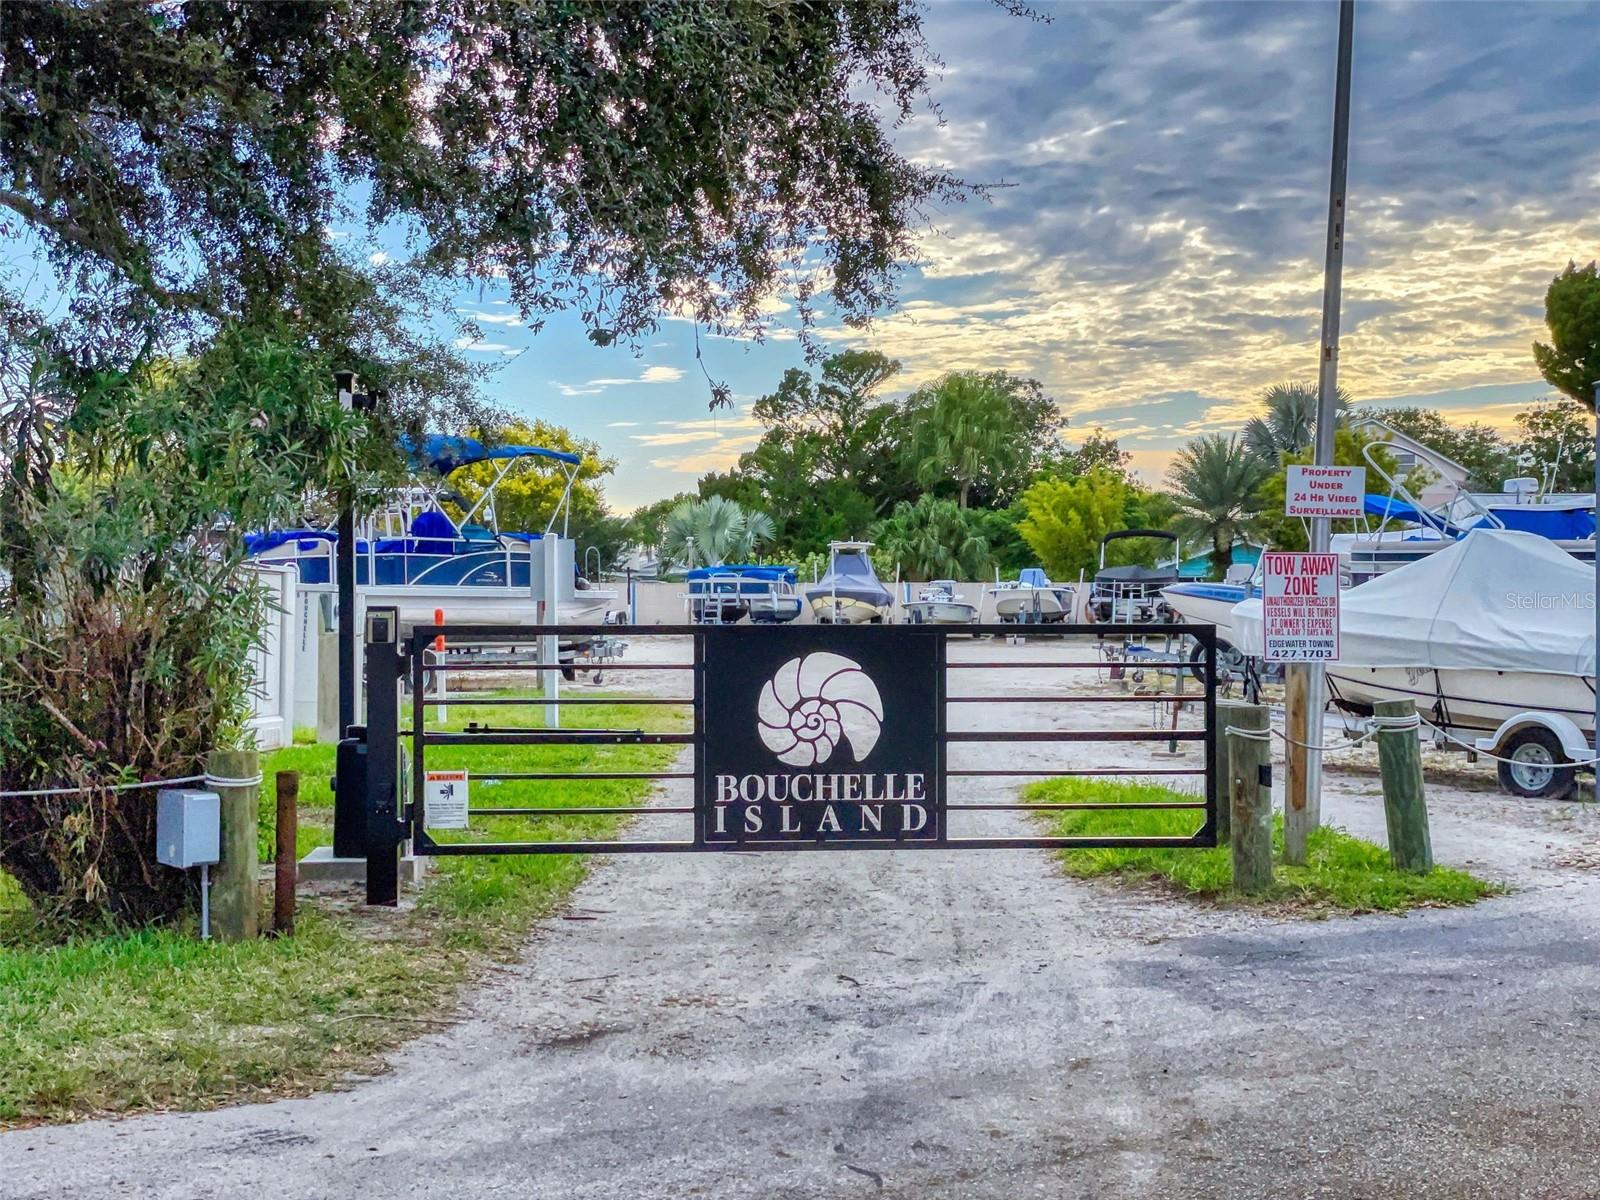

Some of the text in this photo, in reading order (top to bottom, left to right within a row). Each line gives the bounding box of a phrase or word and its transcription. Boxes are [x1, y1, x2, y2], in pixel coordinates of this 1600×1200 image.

[1302, 467, 1352, 477] PROPERTY
[1309, 481, 1343, 489] UNDER
[1294, 493, 1307, 501] 24
[1328, 494, 1357, 503] VIDEO
[1289, 506, 1361, 516] SURVEILLANCE
[1266, 556, 1336, 576] TOW AWAY
[1284, 576, 1318, 596] ZONE
[1266, 597, 1304, 606] UNAUTHORIZED
[1305, 597, 1328, 606] VEHICLES
[1266, 608, 1336, 618] VESSELS WILL BE TOWED
[1271, 619, 1332, 629] AT OWNER'S EXPENSE
[1269, 640, 1334, 648] EDGEWATER TOWING
[1271, 650, 1332, 658] 427-1703
[715, 773, 926, 802] BOUCHELLE
[714, 804, 928, 833] ISLAND
